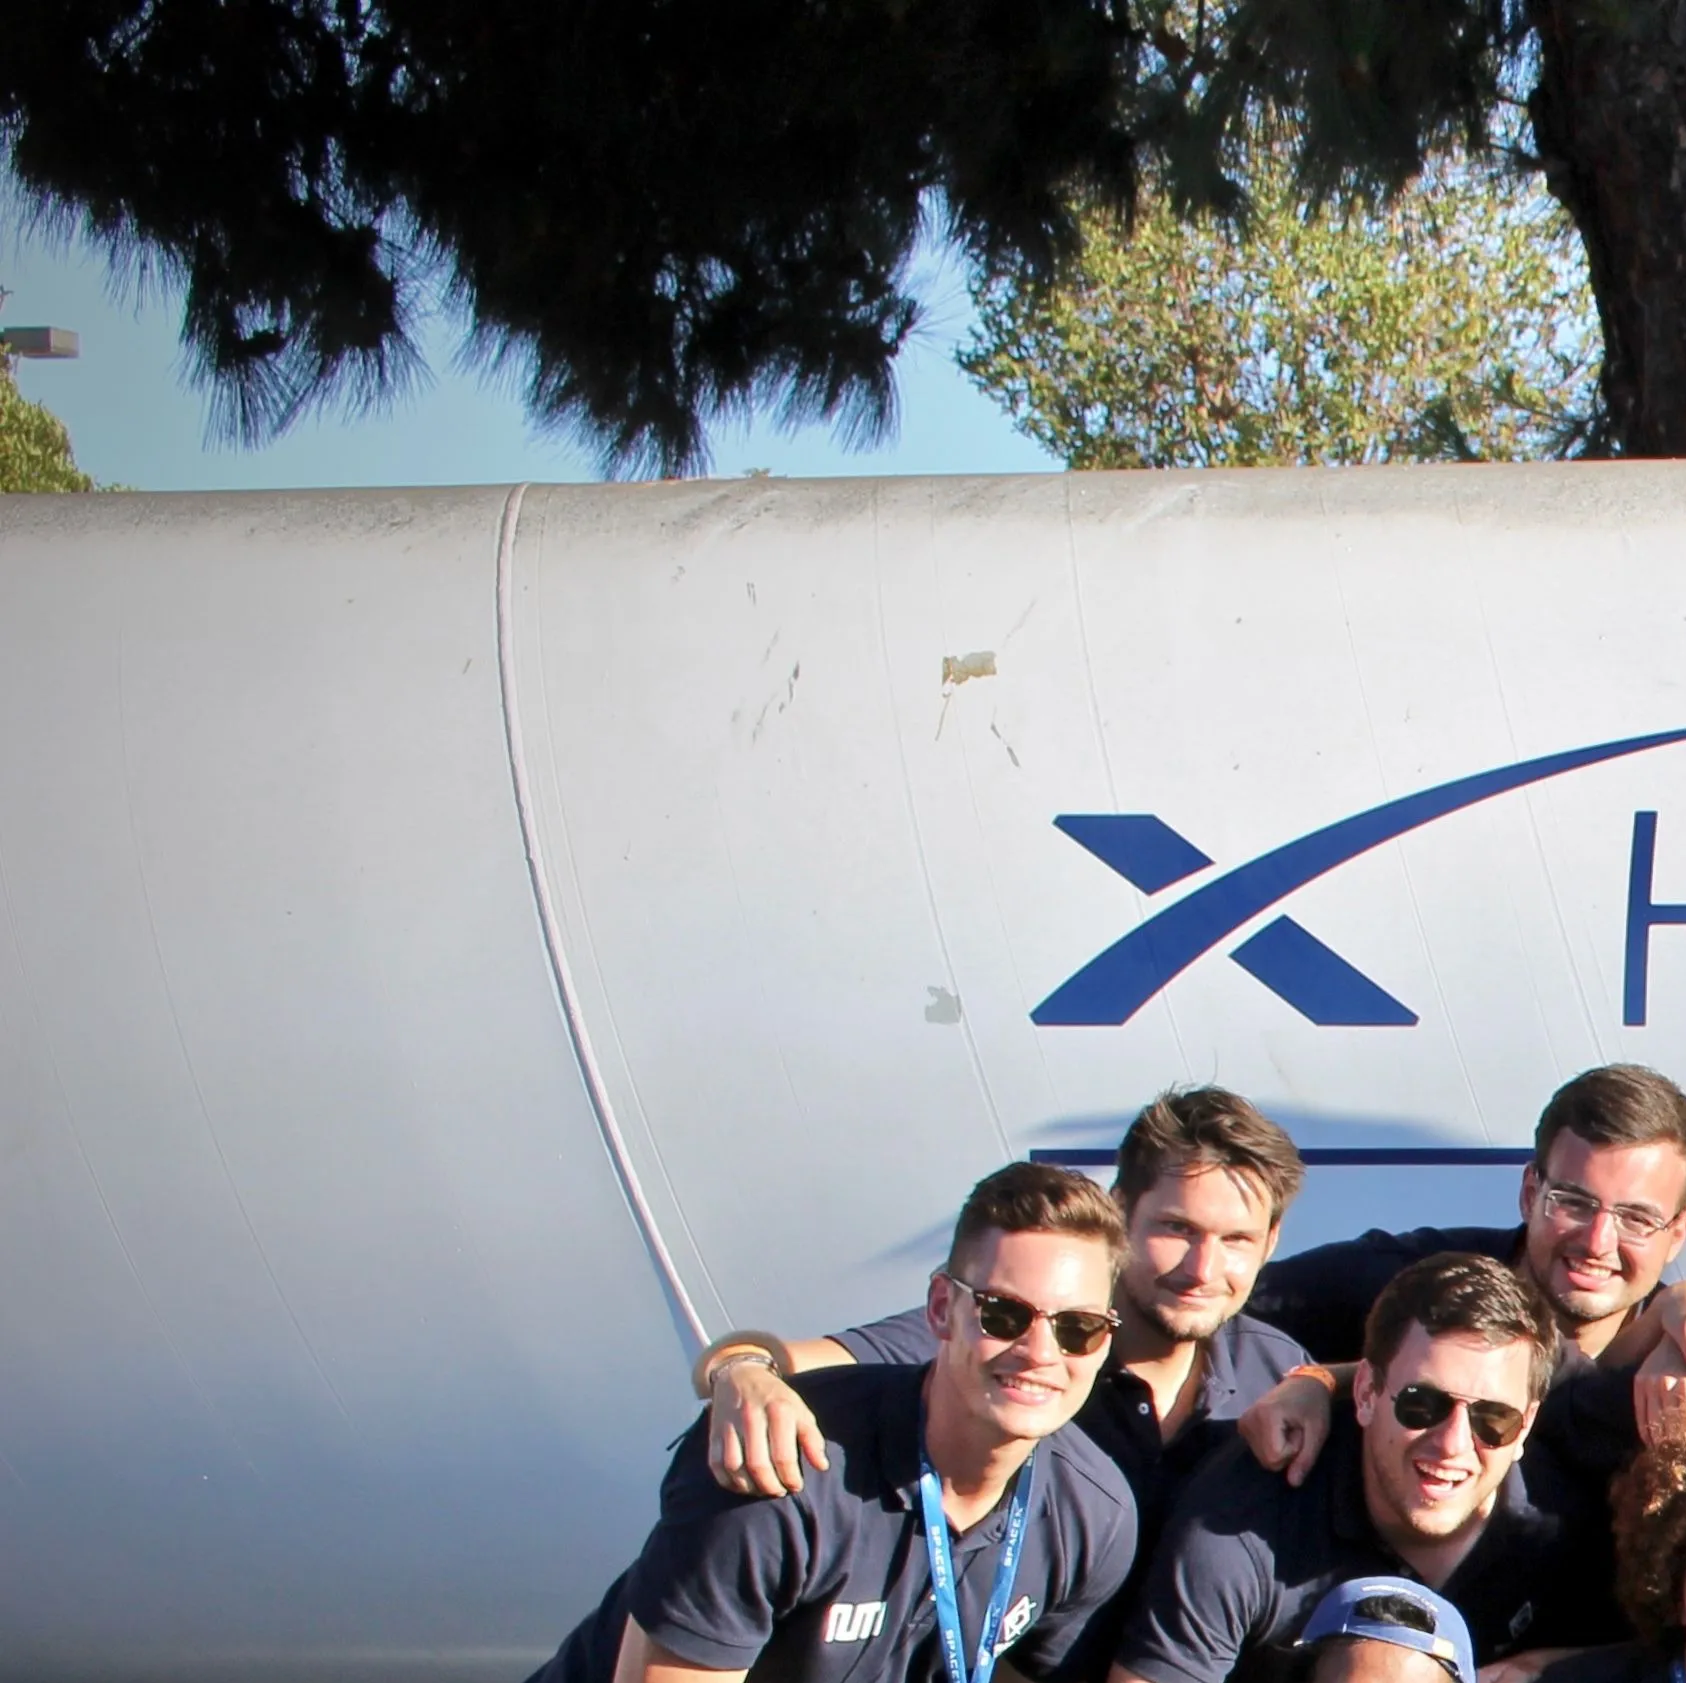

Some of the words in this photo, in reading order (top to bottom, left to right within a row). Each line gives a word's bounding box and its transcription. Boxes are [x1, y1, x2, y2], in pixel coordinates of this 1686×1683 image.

[931, 1525, 948, 1589] SPACEX
[1004, 1506, 1025, 1567] SPACEX
[824, 1601, 887, 1644] TUM
